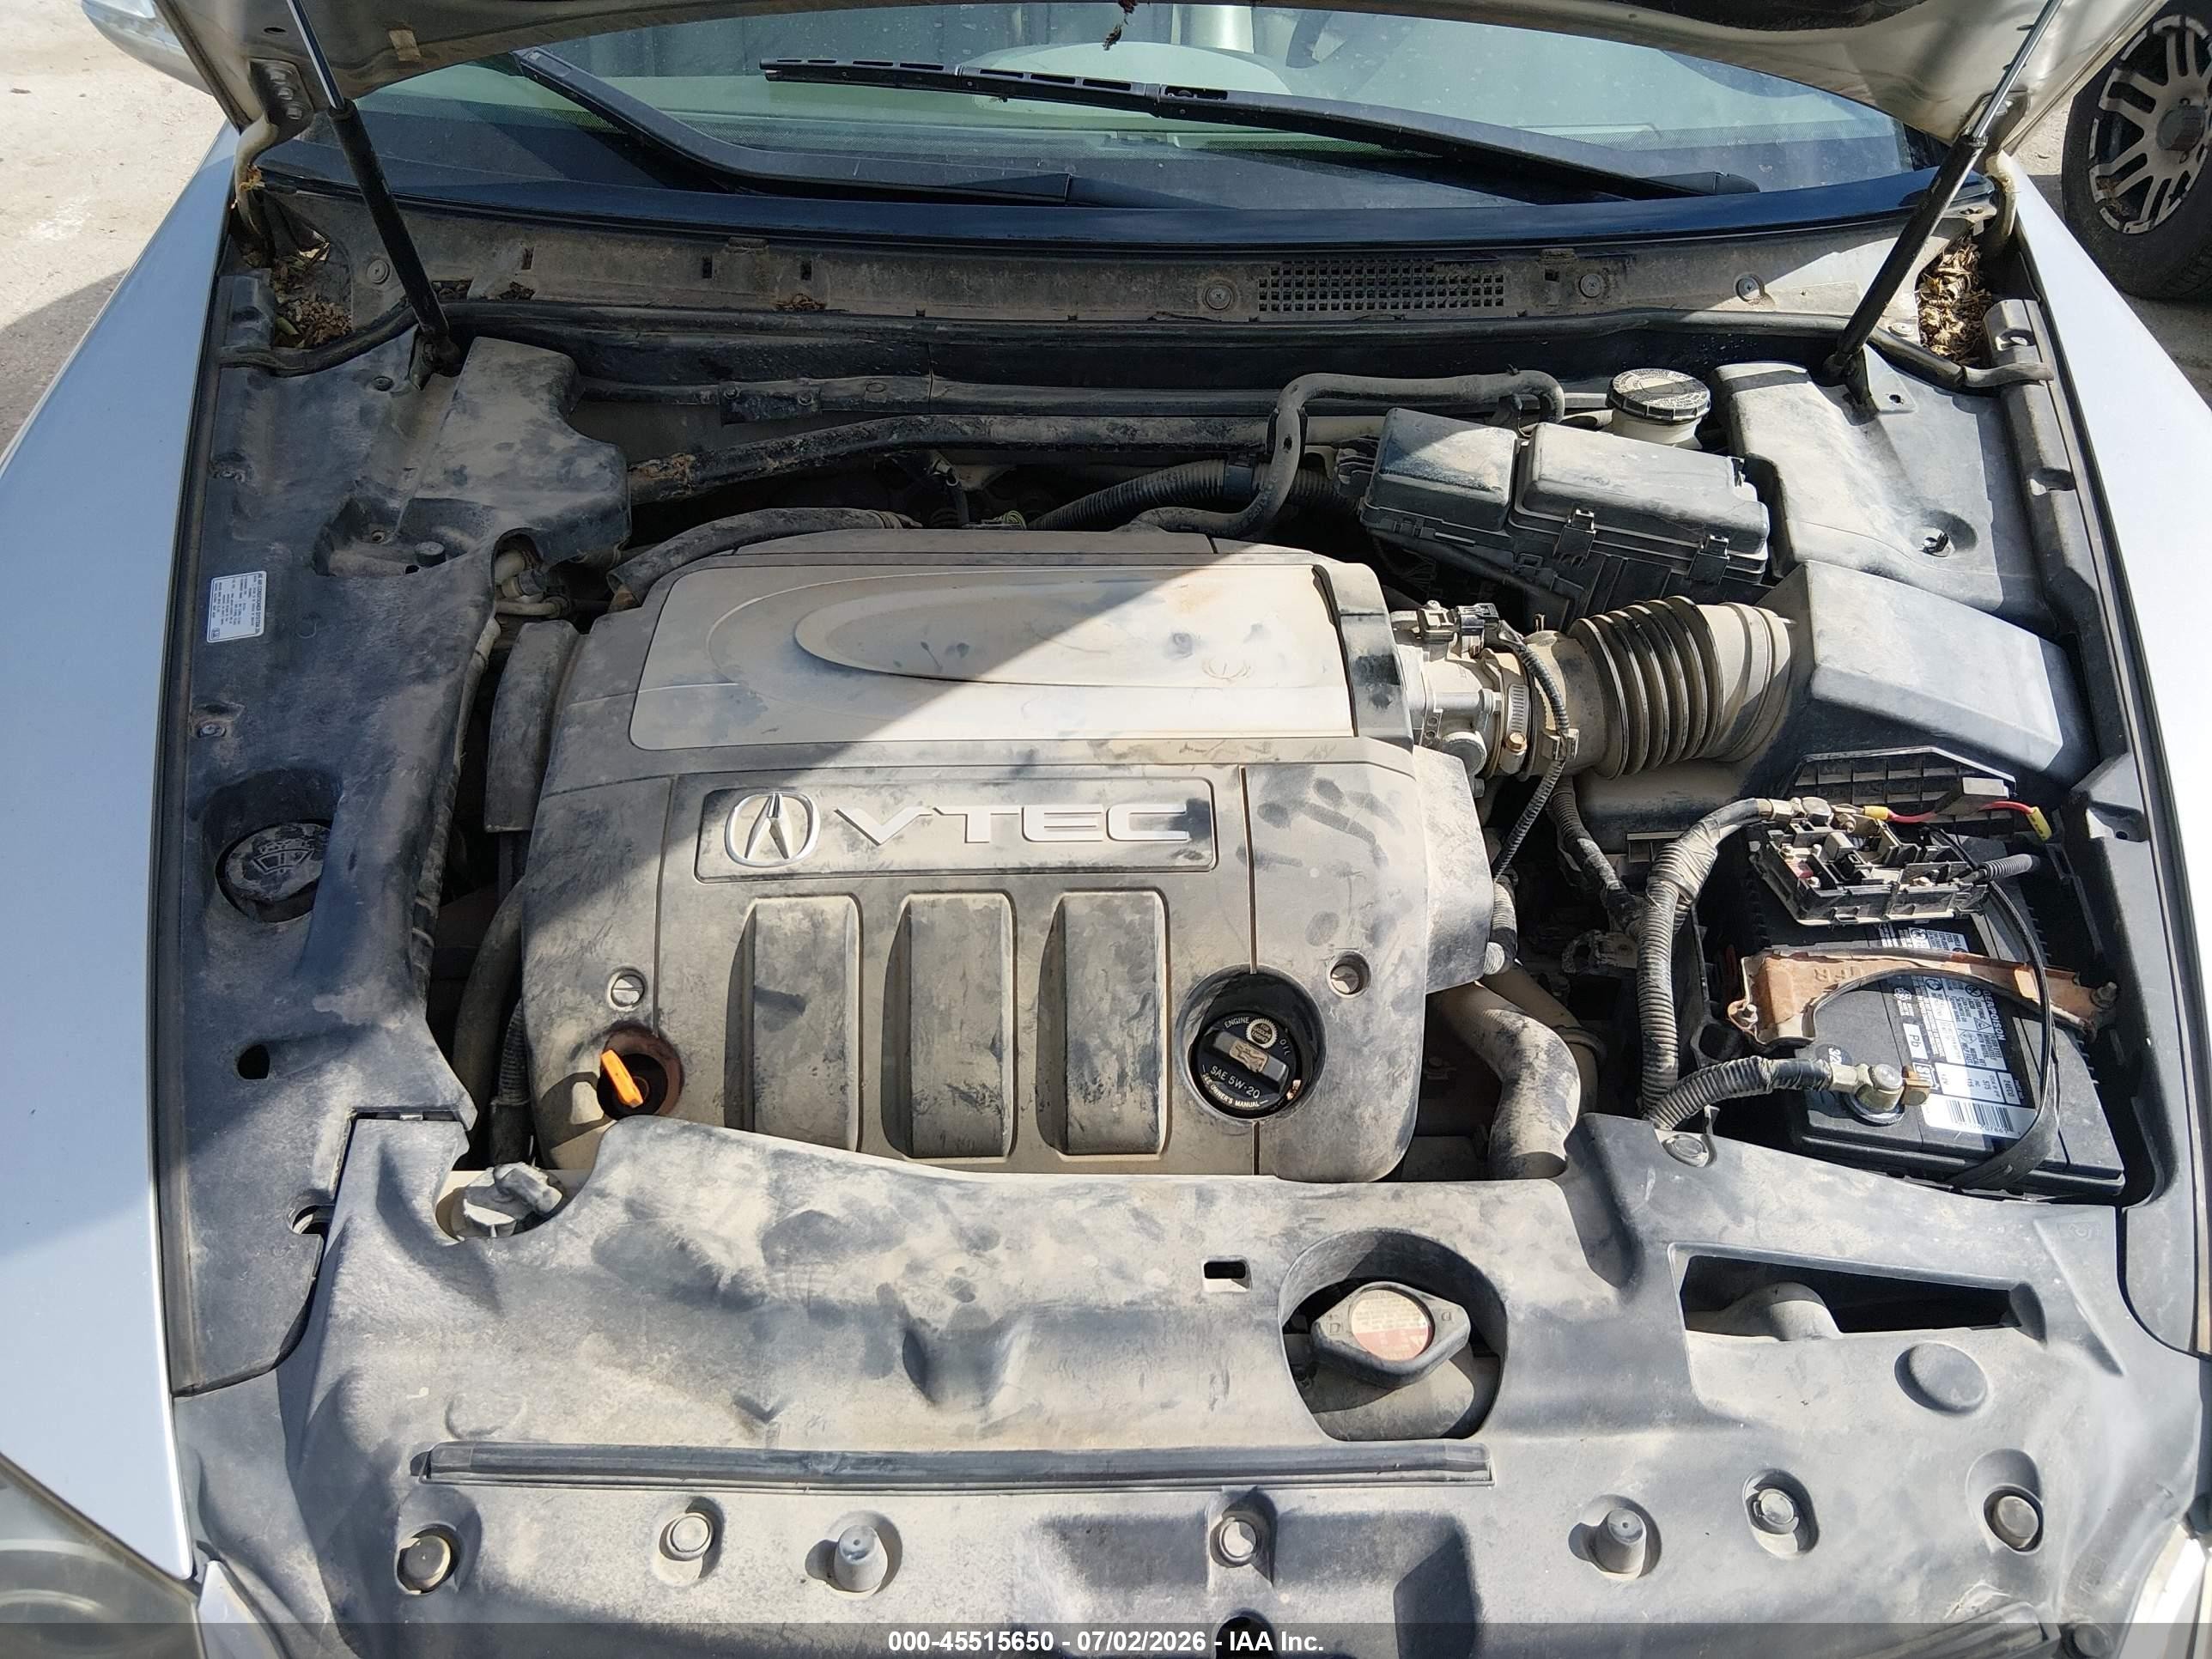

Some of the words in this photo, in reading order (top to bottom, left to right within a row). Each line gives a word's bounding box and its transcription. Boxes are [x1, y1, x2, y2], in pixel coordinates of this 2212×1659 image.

[834, 805, 1190, 845] VTEC
[1224, 1017, 1249, 1029] ENGINE
[1279, 1038, 1291, 1056] OIL
[1910, 1034, 1921, 1048] Pb
[1202, 1073, 1211, 1085] SEE
[1211, 1084, 1233, 1104] OWNER'S
[1210, 1065, 1228, 1080] SAE
[1228, 1073, 1261, 1099] 5W-20
